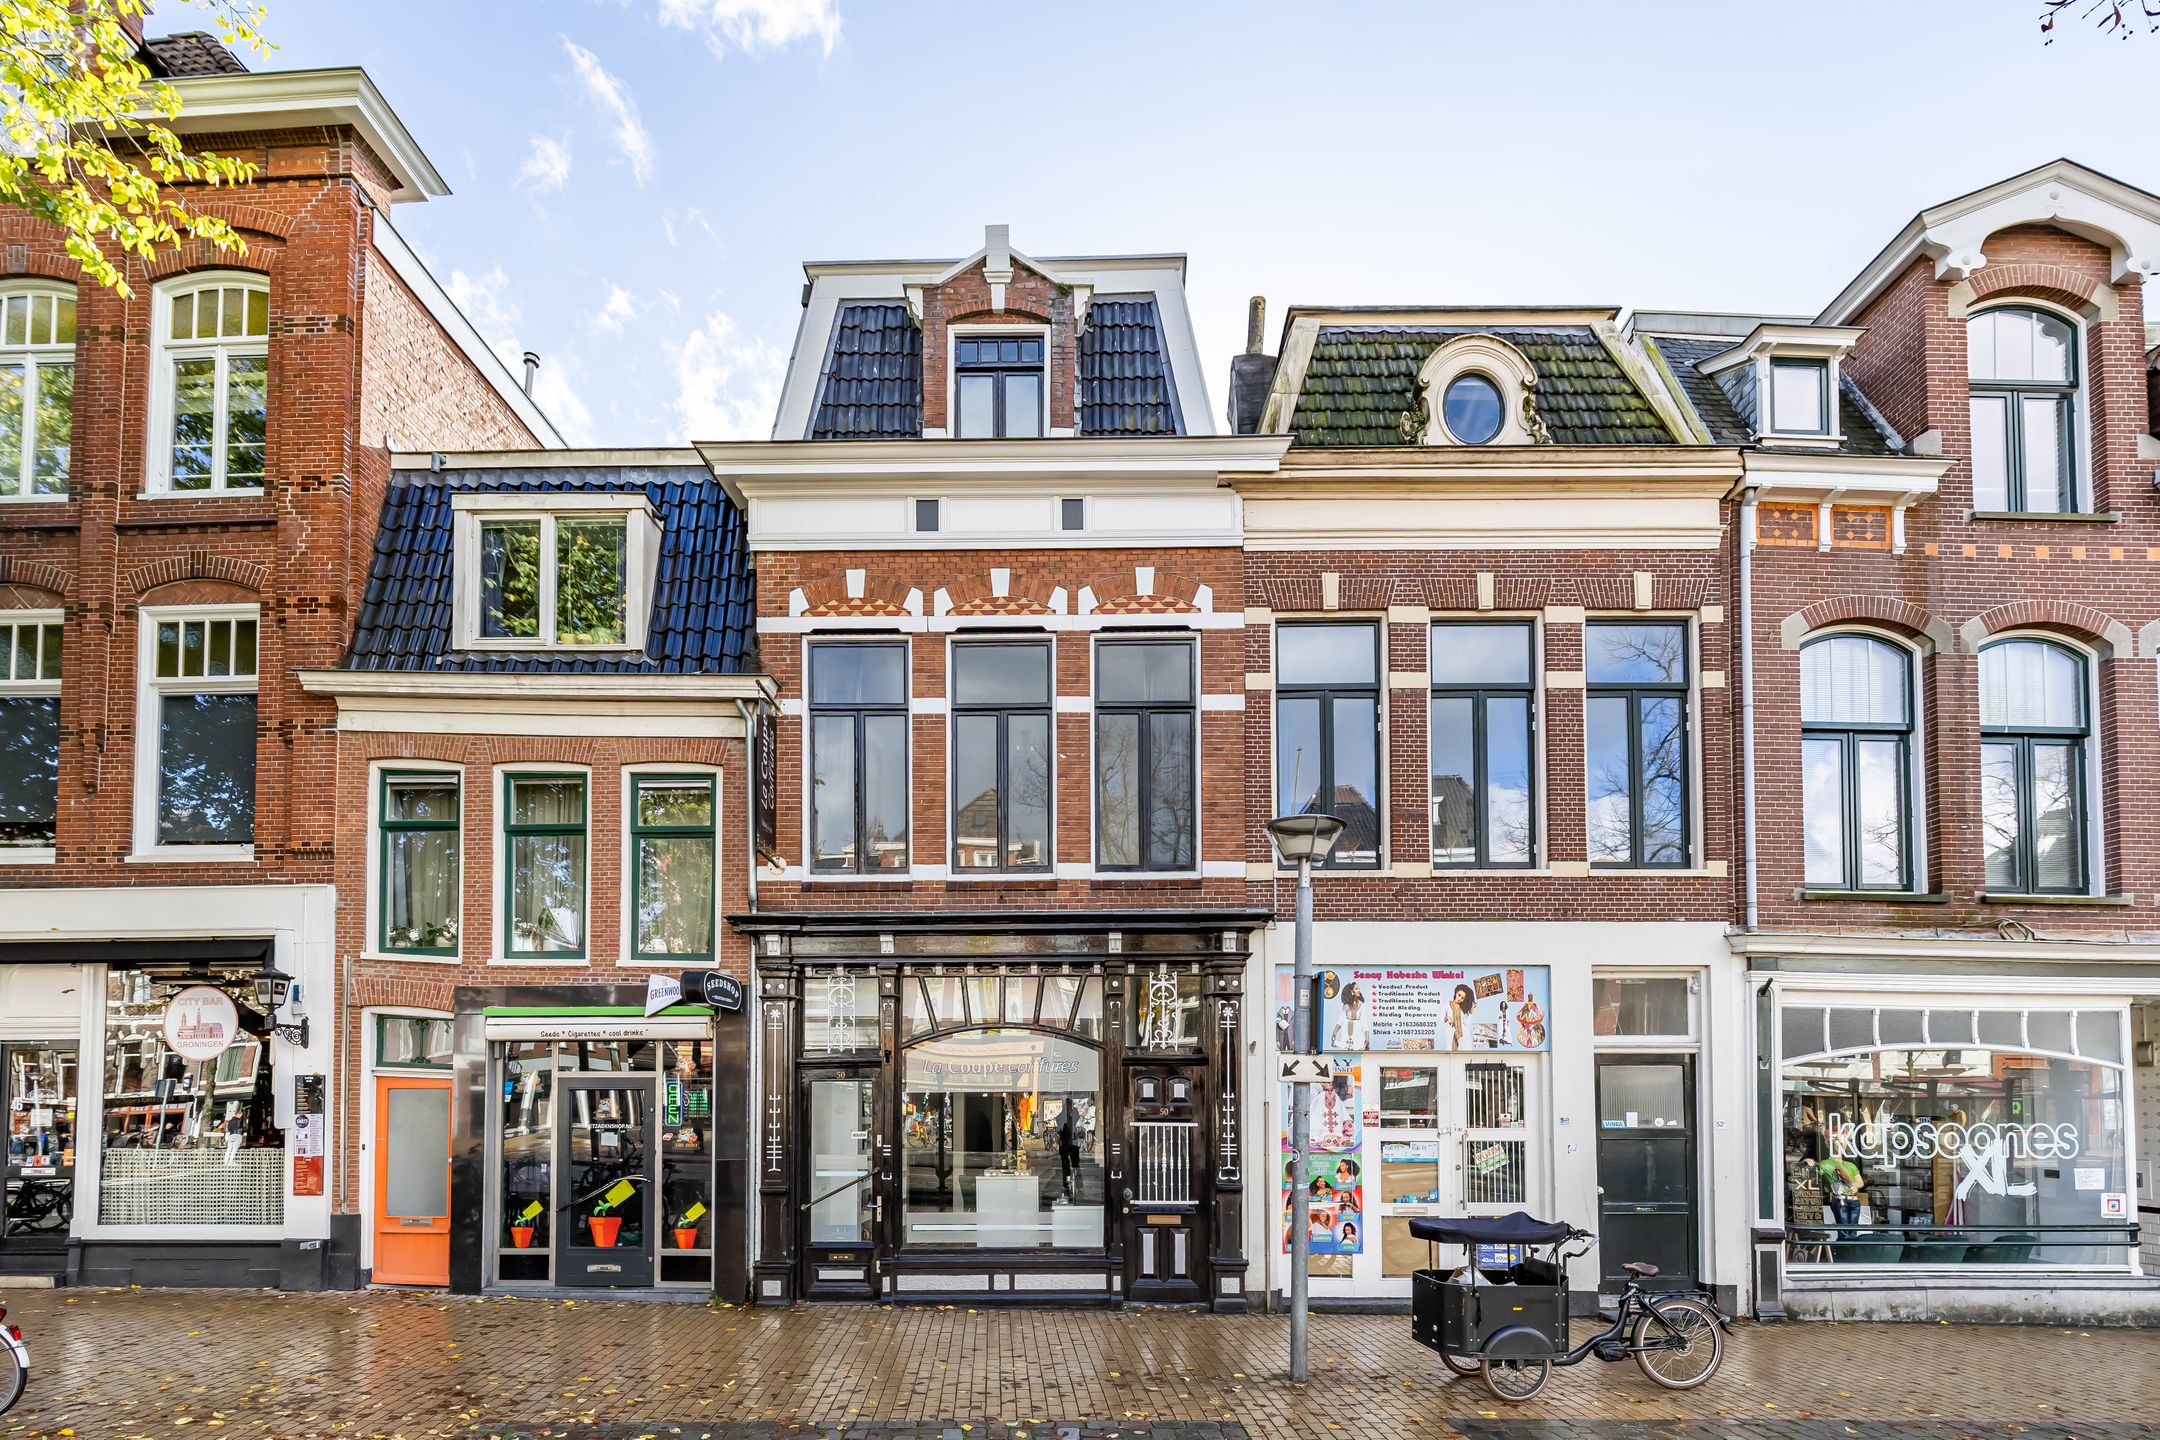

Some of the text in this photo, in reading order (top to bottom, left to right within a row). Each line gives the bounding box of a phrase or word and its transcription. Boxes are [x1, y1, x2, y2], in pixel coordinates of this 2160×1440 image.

[760, 714, 769, 810] La Coupe
[1386, 970, 1428, 979] Habesha
[1432, 970, 1464, 979] Winkel
[650, 986, 680, 1000] GREENWOO
[706, 979, 739, 998] SEEDSHOP
[177, 996, 223, 1006] CITY BAR
[567, 1030, 601, 1038] Cigarettes
[177, 1041, 224, 1049] GRONINGEN
[923, 1059, 943, 1074] La
[947, 1059, 1004, 1077] Coupe
[1828, 1112, 2079, 1168] kapsoones
[1955, 1137, 2038, 1201] XL
[1794, 1179, 1820, 1190] XL
